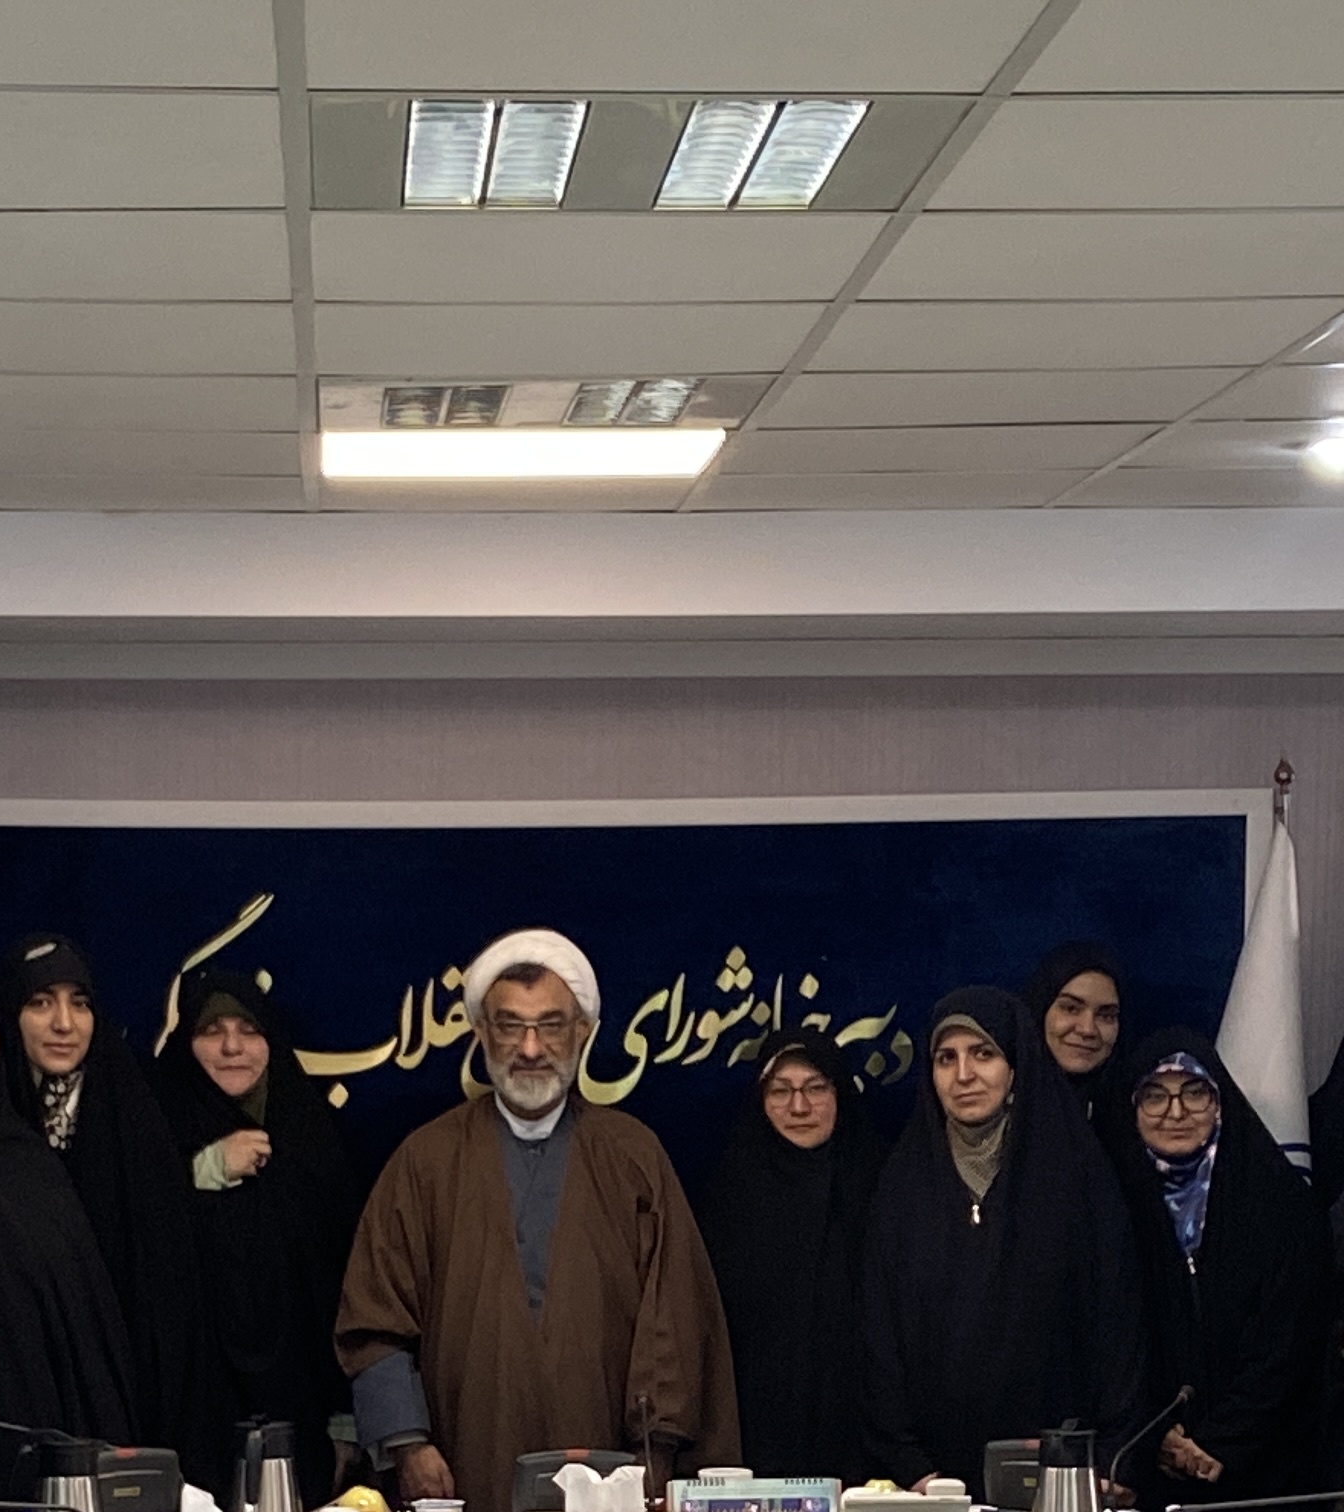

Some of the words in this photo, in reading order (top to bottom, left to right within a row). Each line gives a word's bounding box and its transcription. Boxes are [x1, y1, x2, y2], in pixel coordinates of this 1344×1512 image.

[292, 966, 473, 1109] قلاب
[577, 945, 754, 1106] شورای
[725, 973, 914, 1094] دبخانه
